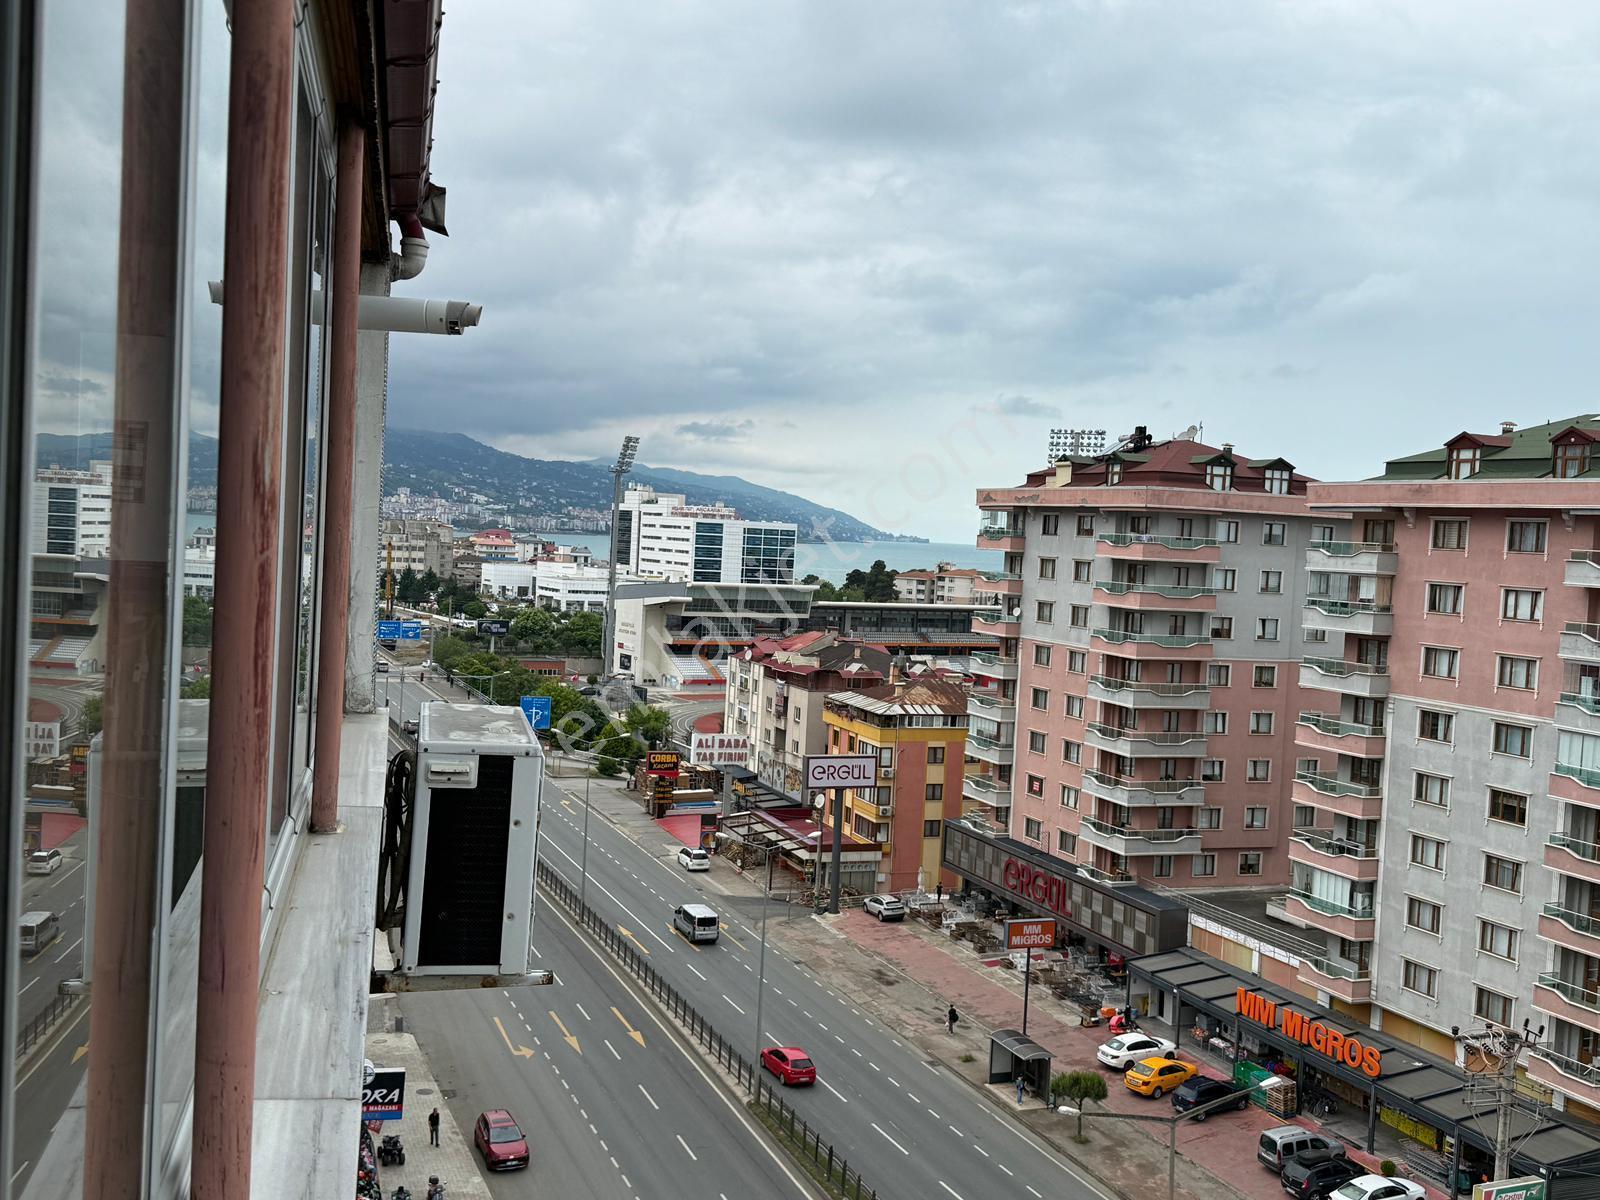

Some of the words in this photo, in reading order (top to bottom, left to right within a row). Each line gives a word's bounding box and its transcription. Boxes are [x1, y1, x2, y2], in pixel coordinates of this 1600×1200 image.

[697, 736, 715, 748] ALİ
[718, 738, 748, 748] BABA
[650, 754, 678, 763] ÇORBA
[717, 752, 748, 762] FIRINI
[1023, 925, 1042, 934] MM
[1236, 986, 1278, 1030] MM
